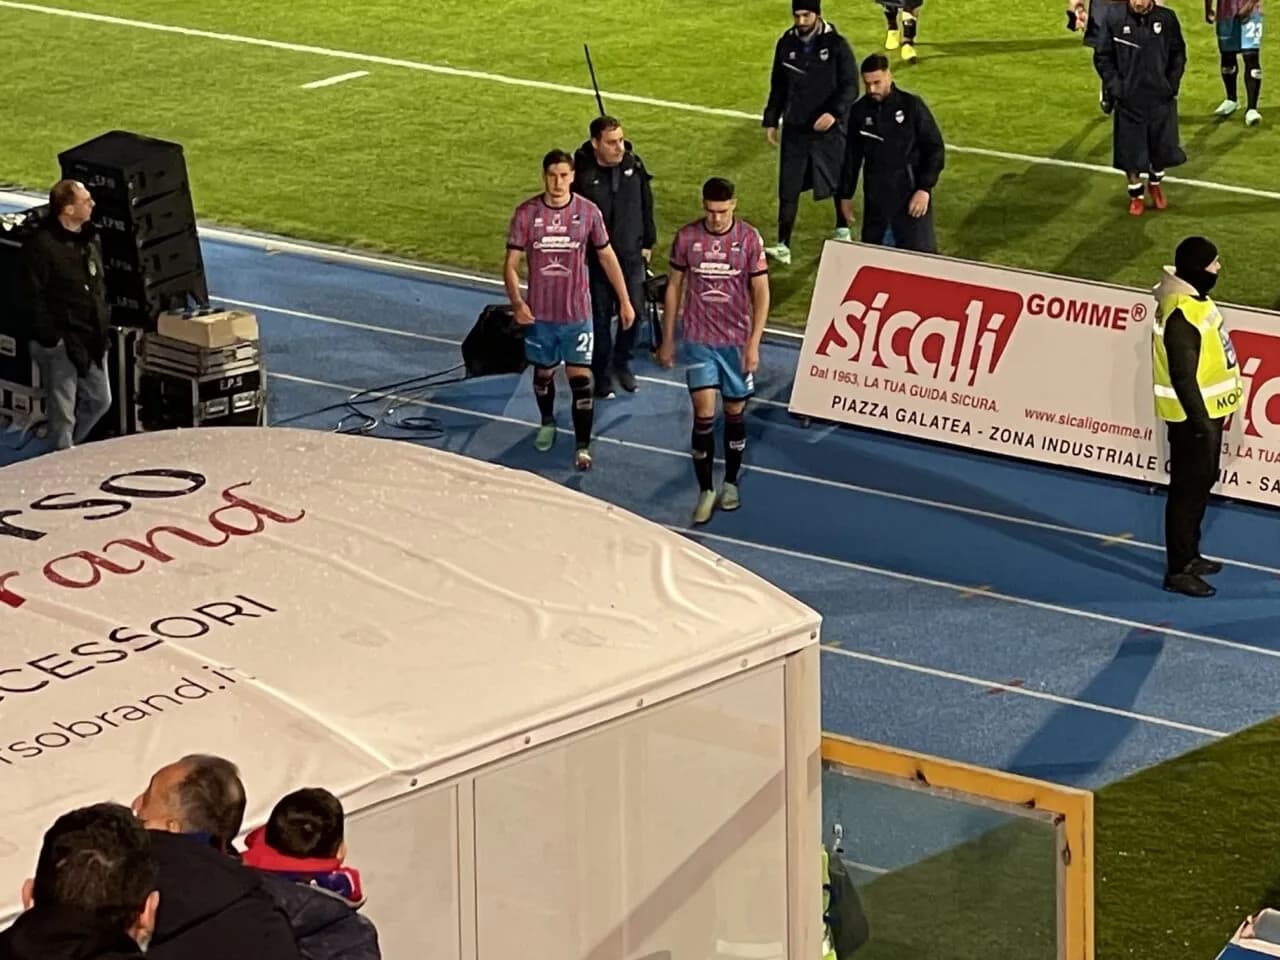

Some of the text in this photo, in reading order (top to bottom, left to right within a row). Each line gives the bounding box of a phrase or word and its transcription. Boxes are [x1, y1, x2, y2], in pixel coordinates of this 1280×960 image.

[825, 290, 1006, 387] sicali
[810, 364, 1000, 414] Dal 1963, LA TUA GUIDA SICURA.
[831, 395, 889, 420] PIAZZA
[895, 408, 971, 436] GALATEA
[989, 426, 1035, 449] ZONA
[1041, 436, 1158, 471] INDUSTRIALE
[1024, 408, 1153, 441] www.sicaligomme.it
[1236, 444, 1253, 460] LA
